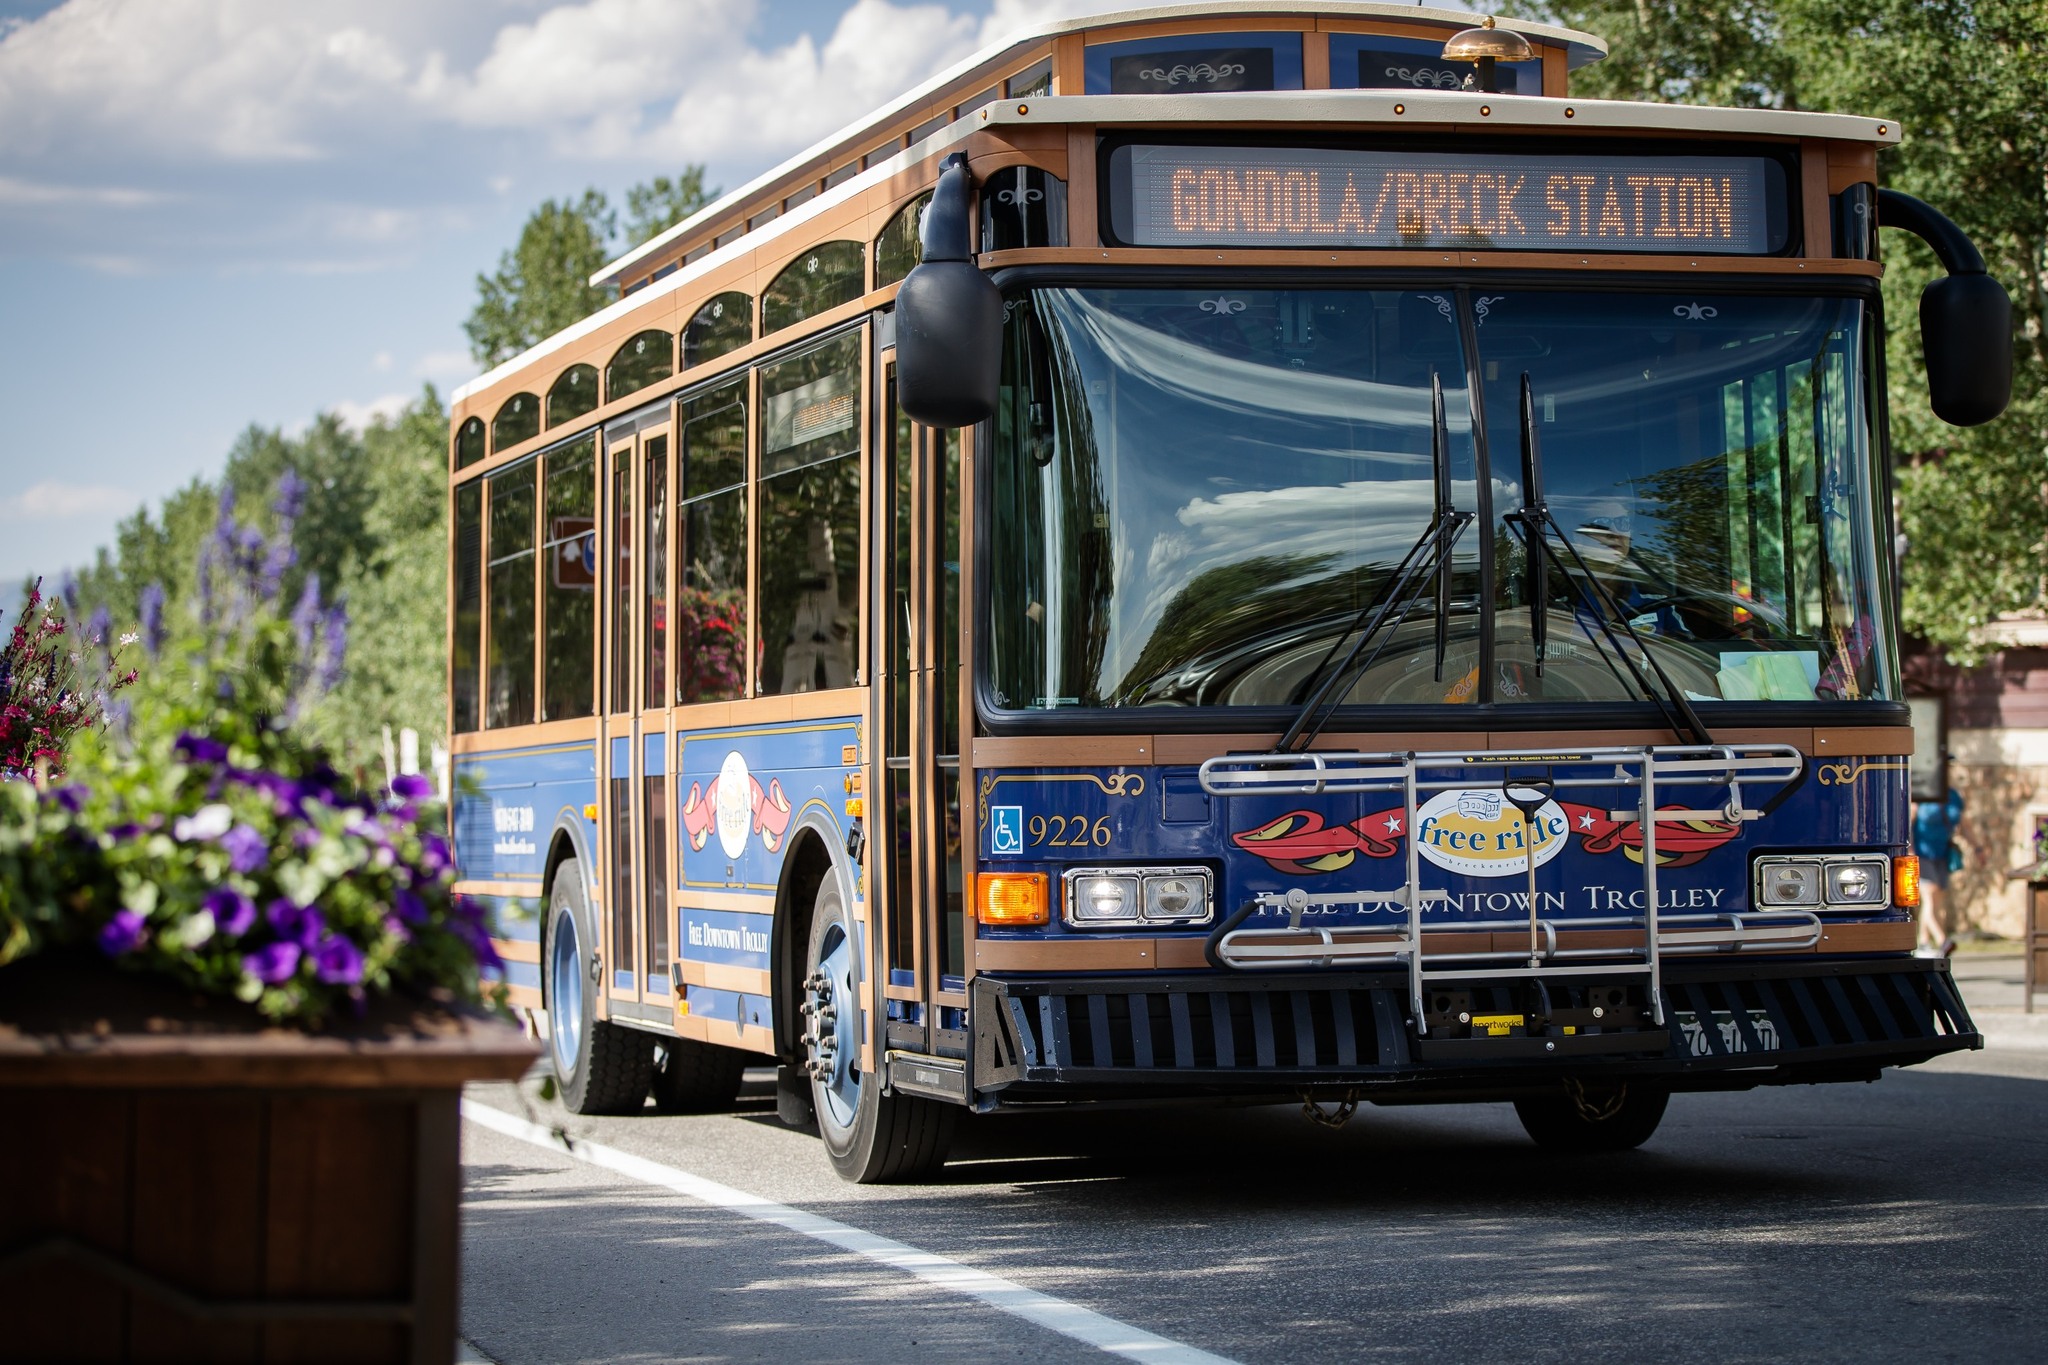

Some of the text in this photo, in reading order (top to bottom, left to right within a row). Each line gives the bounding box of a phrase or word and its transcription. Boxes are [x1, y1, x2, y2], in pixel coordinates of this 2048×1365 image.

[1172, 169, 1732, 238] GONDOLA/BRECK STATION
[1028, 815, 1112, 847] 9226
[1417, 815, 1566, 851] free ride
[1448, 854, 1541, 869] breckenride
